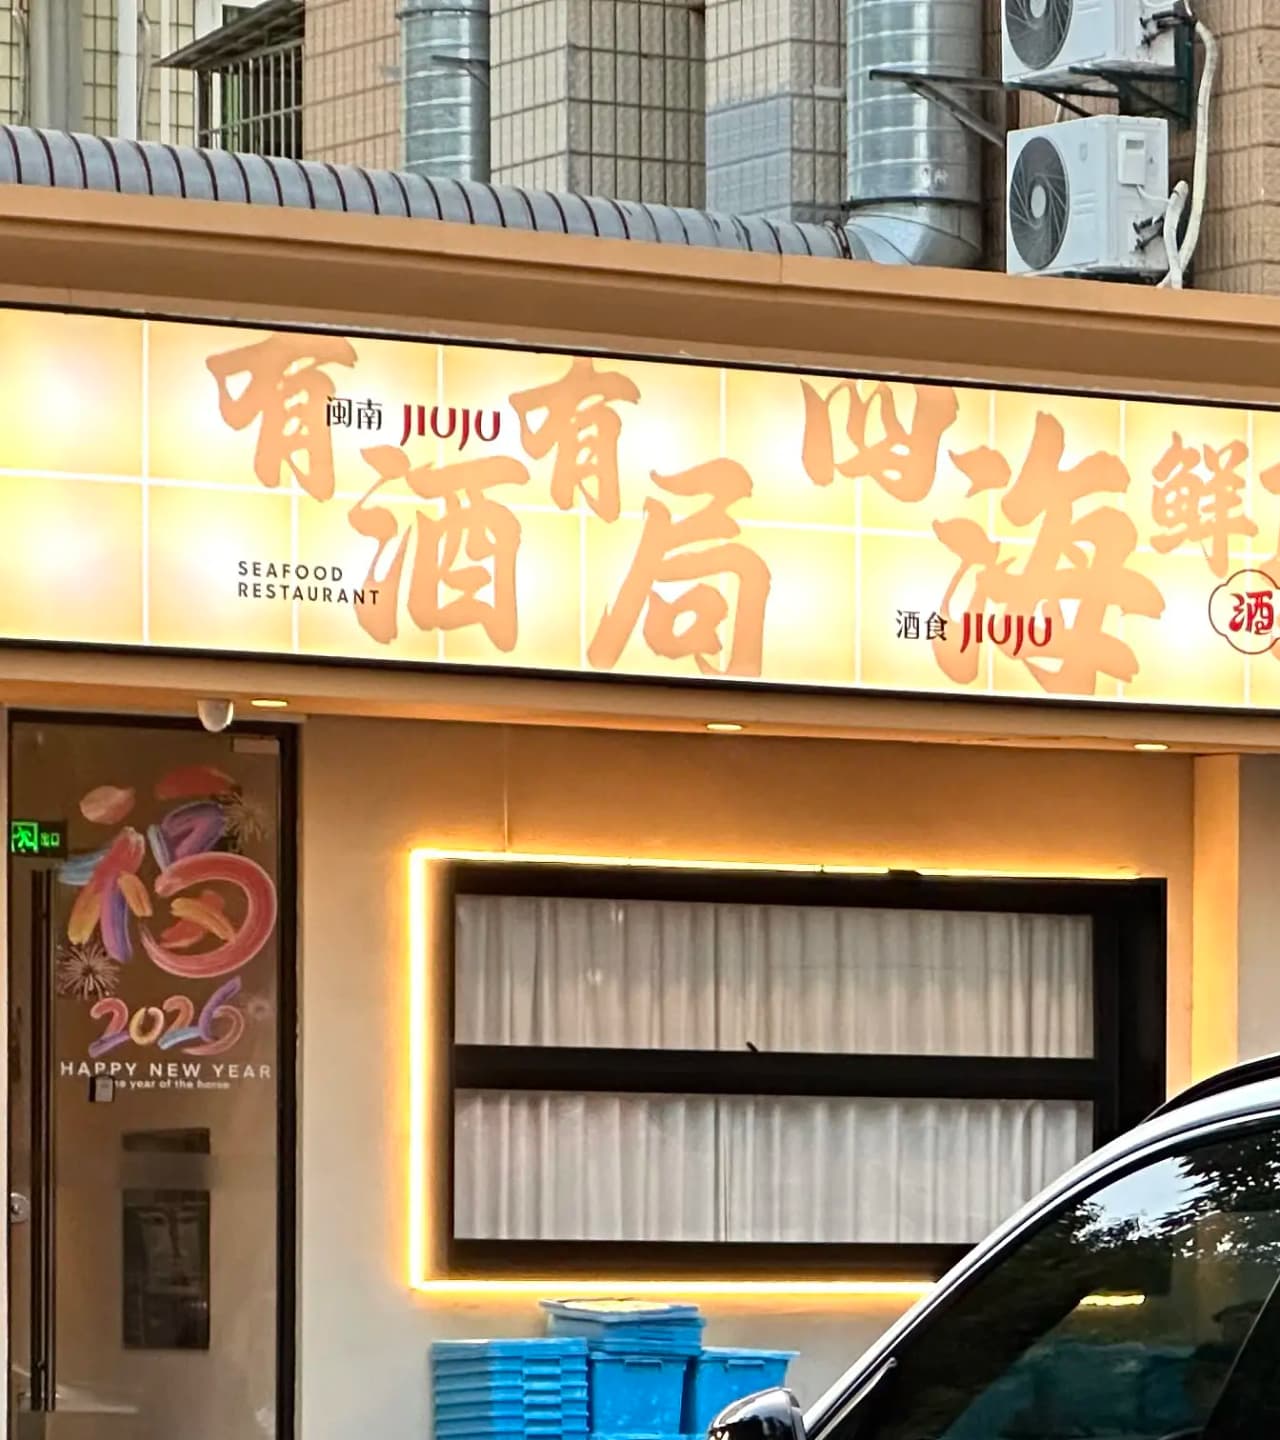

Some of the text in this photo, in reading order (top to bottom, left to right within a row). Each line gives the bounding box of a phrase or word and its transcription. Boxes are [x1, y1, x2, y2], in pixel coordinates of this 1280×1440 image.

[325, 396, 383, 431] 闽南
[400, 404, 501, 451] JIUJU
[238, 560, 343, 582] SEAFOOD
[238, 582, 379, 606] RESTAURANT
[896, 609, 948, 641] 酒食
[960, 612, 1052, 656] JIUJU
[88, 976, 244, 1058] 2026
[60, 1061, 272, 1079] HAPPY NEW YEAR
